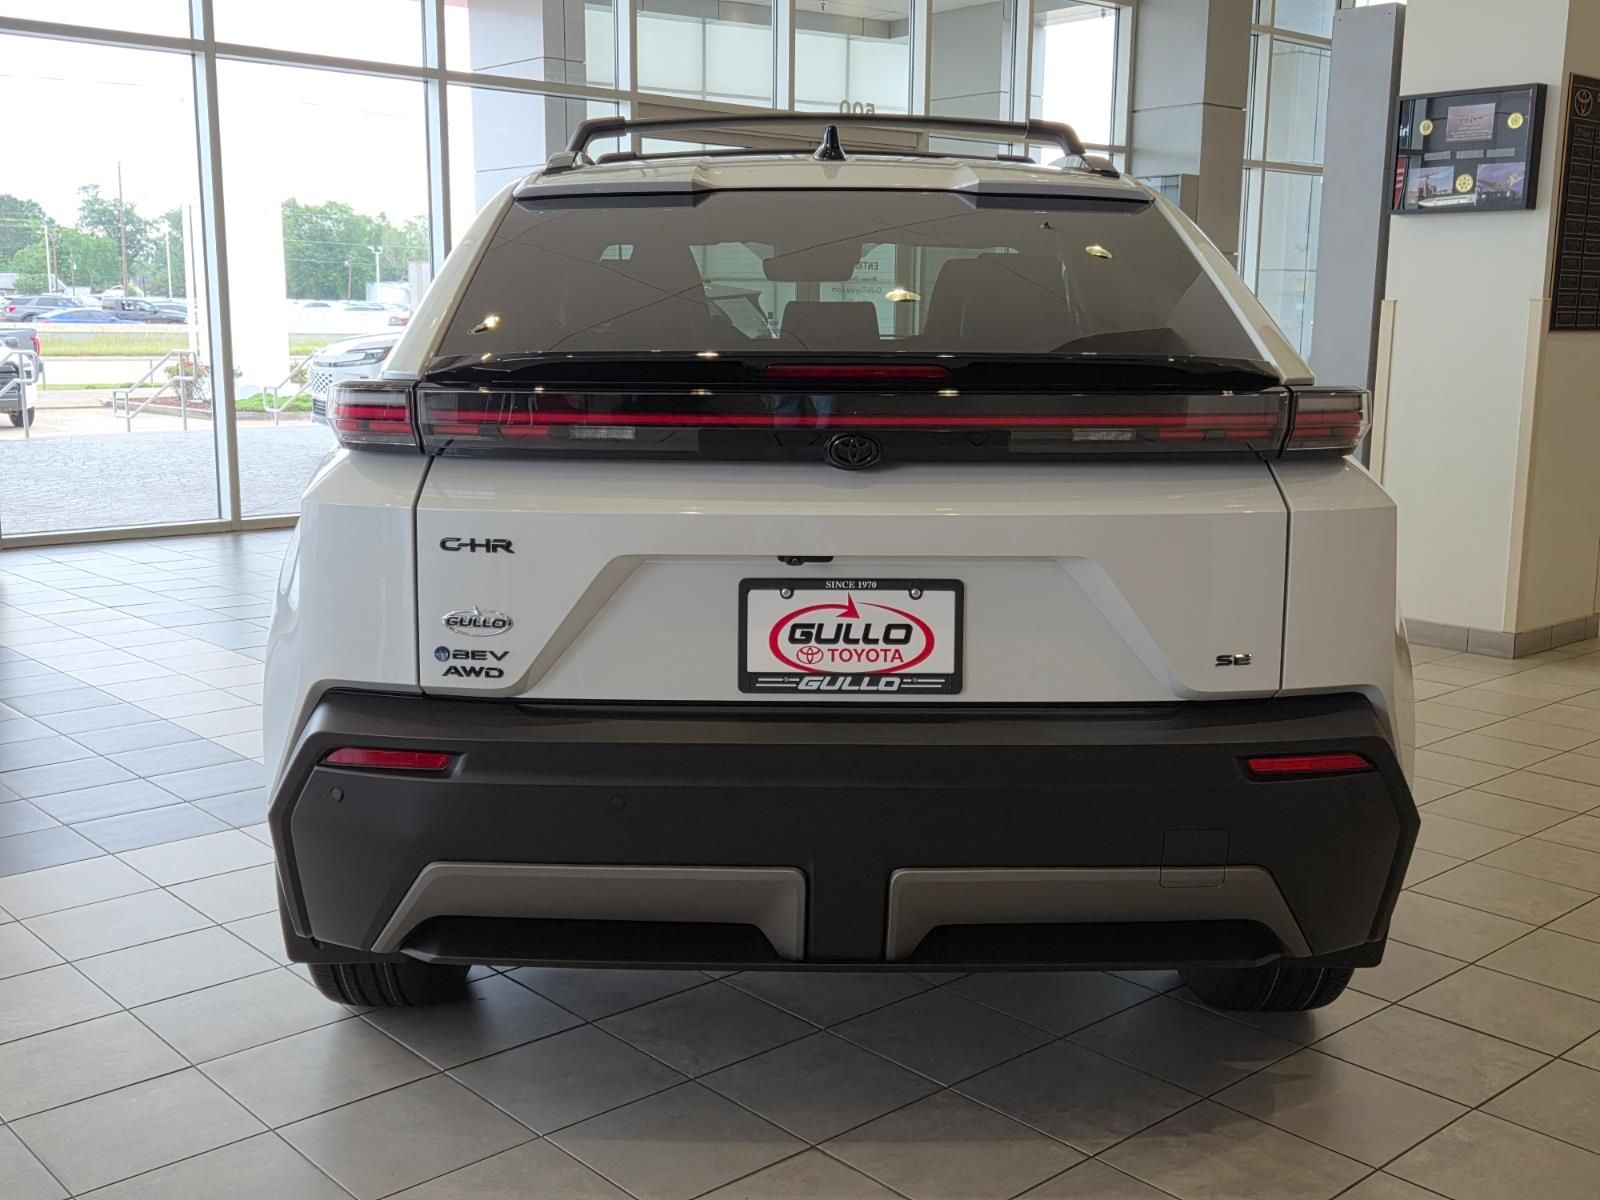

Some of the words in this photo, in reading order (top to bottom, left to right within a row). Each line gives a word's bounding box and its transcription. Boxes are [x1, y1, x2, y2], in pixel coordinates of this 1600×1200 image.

[439, 537, 516, 554] C-HR
[825, 580, 855, 589] SINCE
[858, 580, 877, 589] 1970
[446, 616, 508, 629] GULLO
[787, 622, 914, 646] GULLO
[451, 649, 510, 662] BEV
[827, 648, 904, 663] TOYOTA
[441, 665, 505, 679] AWD
[797, 676, 901, 692] GULLO
